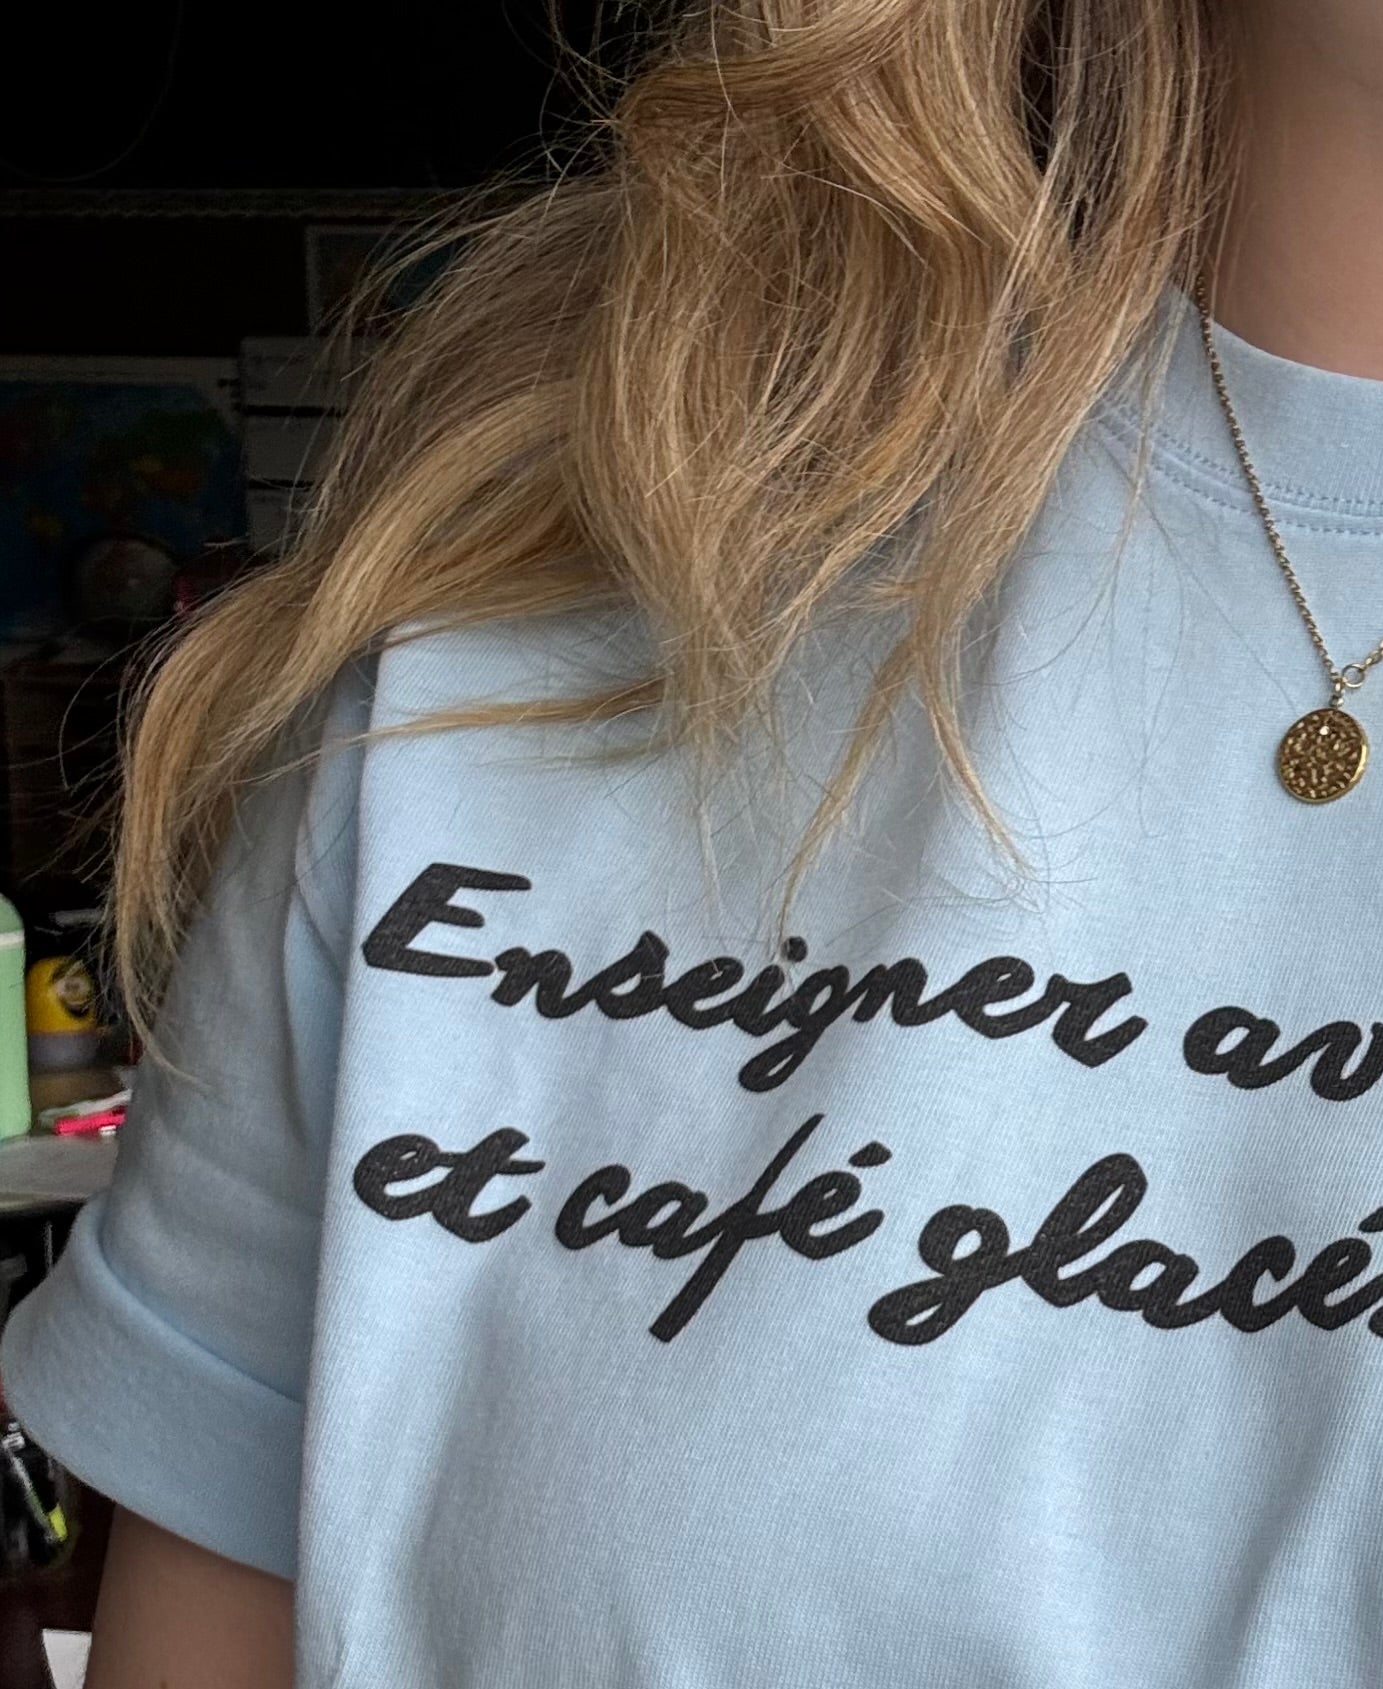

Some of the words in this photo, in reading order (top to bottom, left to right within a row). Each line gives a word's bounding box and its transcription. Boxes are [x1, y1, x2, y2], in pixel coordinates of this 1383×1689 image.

[360, 862, 1149, 1095] Enseigner
[351, 1126, 547, 1244] et
[553, 1111, 892, 1345] café
